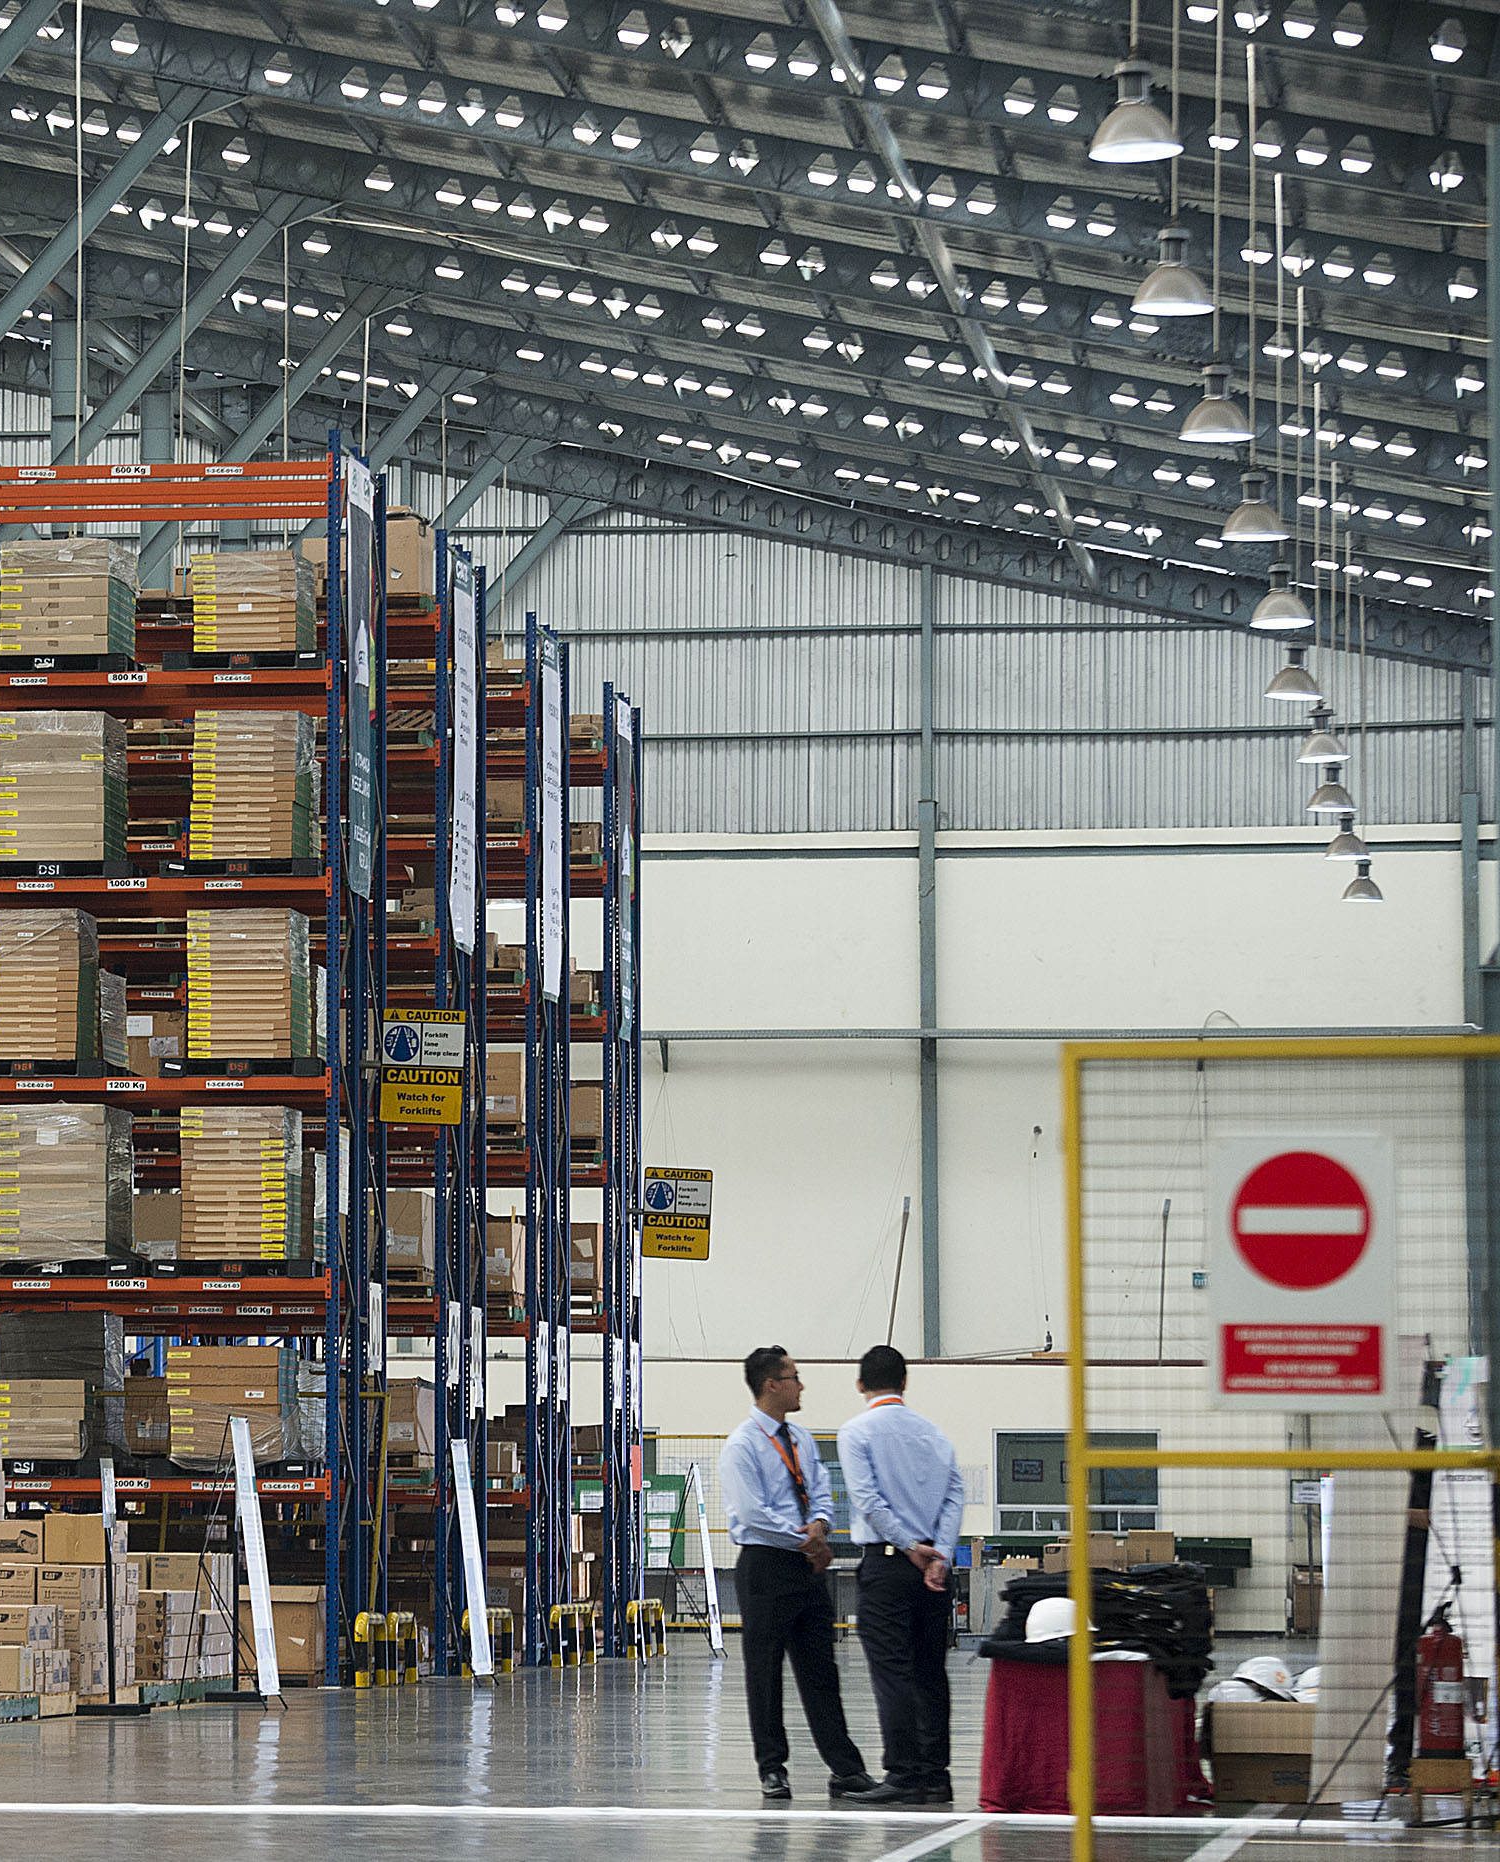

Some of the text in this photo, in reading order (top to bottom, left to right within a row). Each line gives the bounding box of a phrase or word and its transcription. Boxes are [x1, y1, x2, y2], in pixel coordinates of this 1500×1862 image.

[115, 466, 146, 475] 600 Kg
[112, 673, 143, 683] 800 Kg
[38, 864, 60, 875] DSI
[229, 863, 247, 872] DSI
[110, 879, 145, 890] 1000 Kg
[406, 1010, 460, 1022] CAUTION
[424, 1050, 442, 1058] Keep
[386, 1069, 459, 1084] CAUTION
[109, 1080, 144, 1091] 1200 Kg
[397, 1092, 446, 1103] Watch for
[399, 1106, 442, 1116] Forklifts
[663, 1170, 708, 1180] CAUTION
[647, 1215, 707, 1228] CAUTION
[655, 1233, 696, 1242] Watch for
[657, 1244, 693, 1253] Forklifts
[223, 1263, 241, 1273] DSI
[109, 1279, 145, 1289] 1600 Kg
[259, 1307, 271, 1315] Kg
[114, 1479, 150, 1490] 2000 Kg
[263, 1482, 300, 1490] 1-3-CE-01-01
